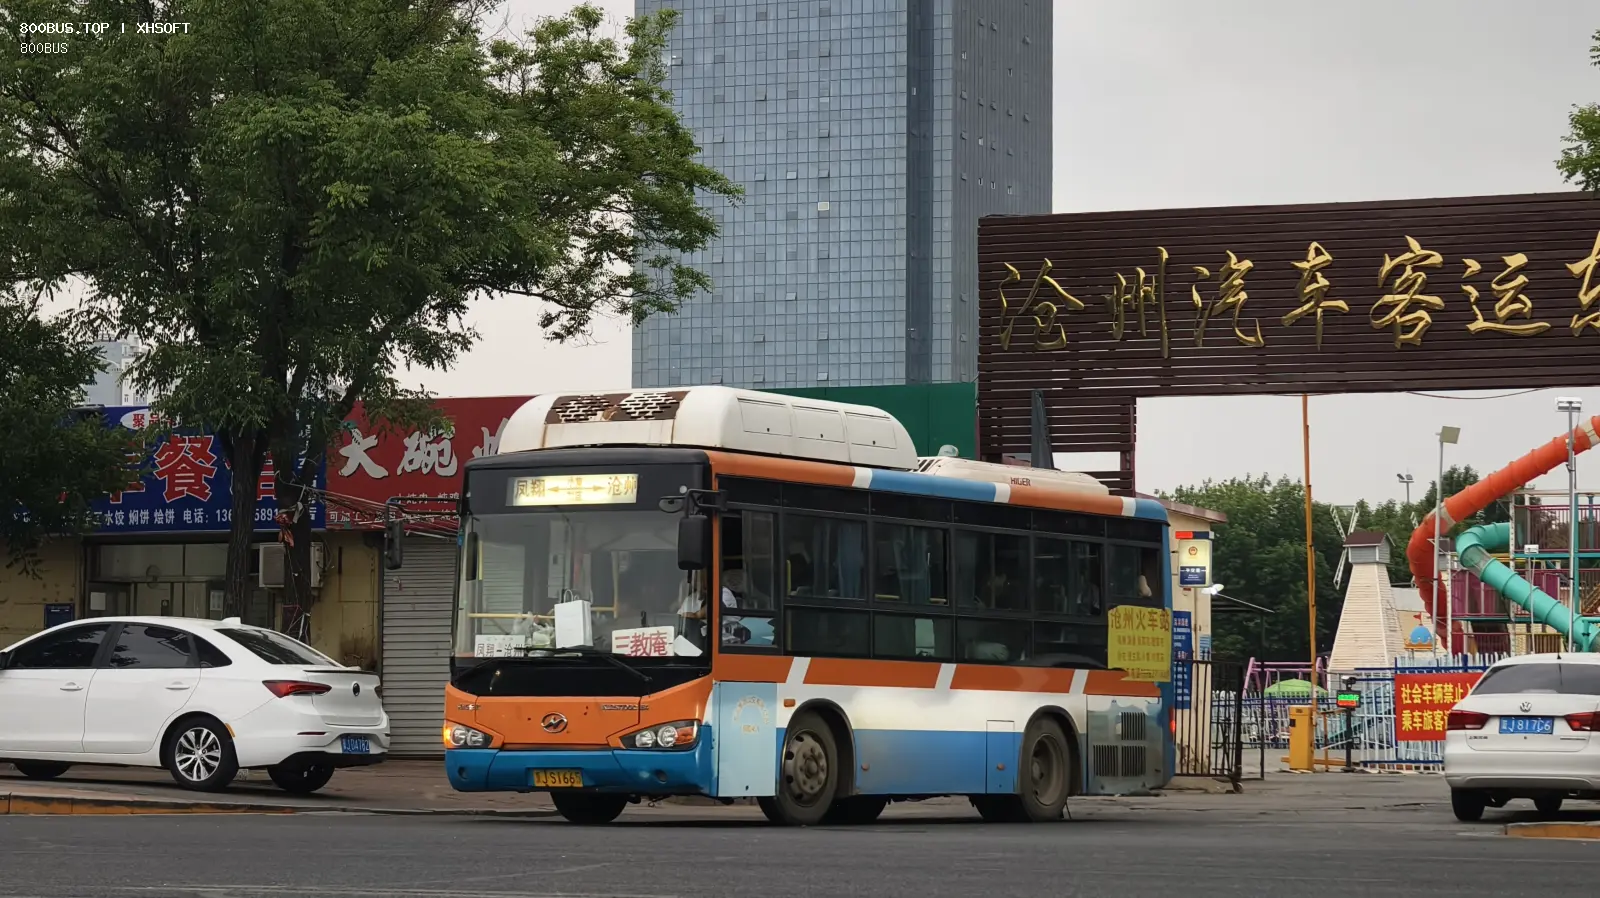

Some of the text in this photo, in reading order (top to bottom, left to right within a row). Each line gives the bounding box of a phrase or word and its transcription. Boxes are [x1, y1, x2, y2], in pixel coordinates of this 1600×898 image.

[607, 475, 638, 496] 沧州
[1010, 476, 1031, 487] HIGER
[1110, 608, 1170, 632] 沧州火车站
